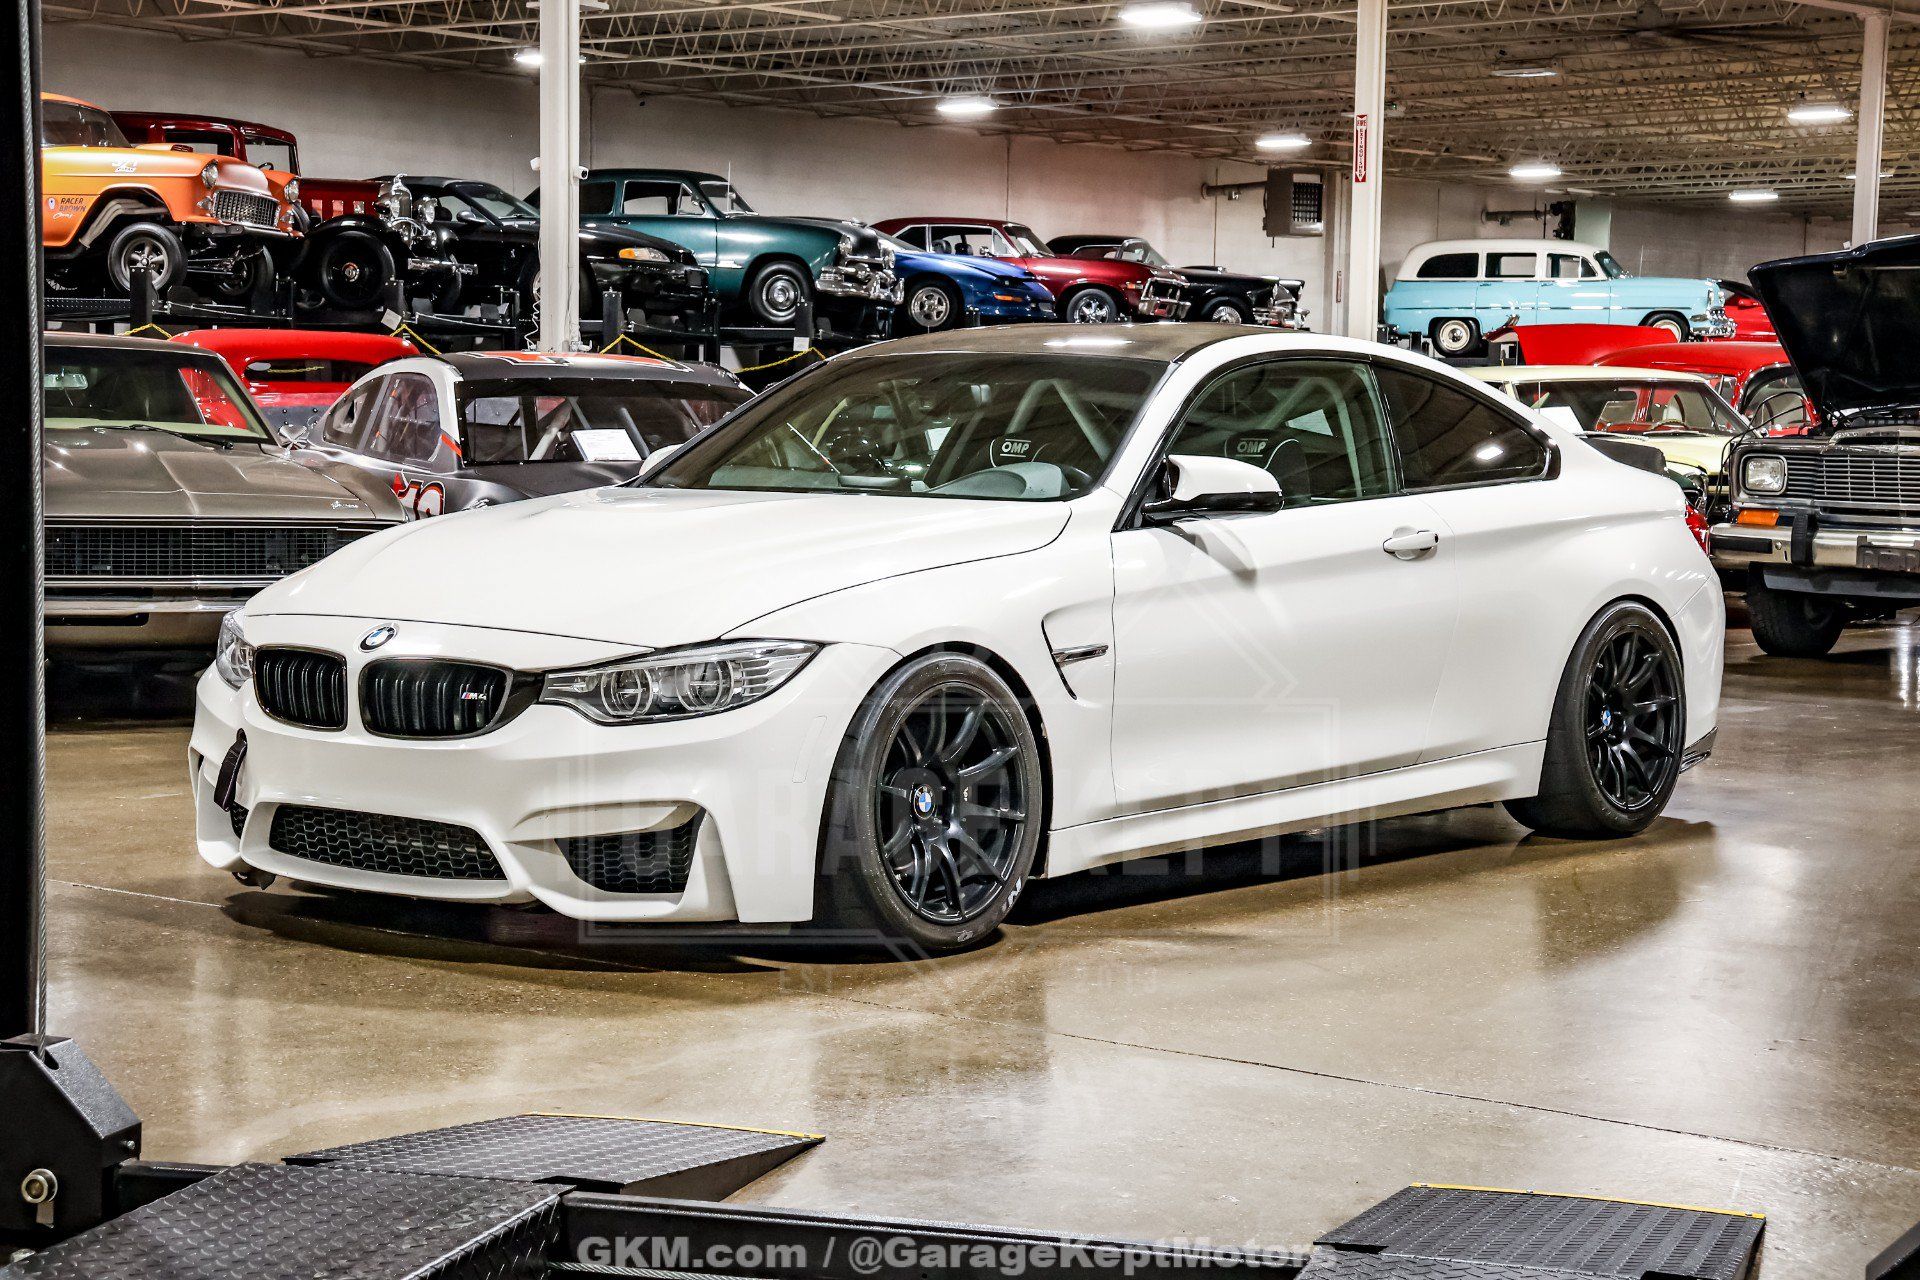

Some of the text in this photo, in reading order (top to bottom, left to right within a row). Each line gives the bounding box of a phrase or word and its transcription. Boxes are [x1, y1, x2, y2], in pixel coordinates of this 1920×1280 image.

[60, 197, 84, 205] RACER
[1001, 440, 1032, 454] OMP
[1236, 440, 1267, 453] OMP
